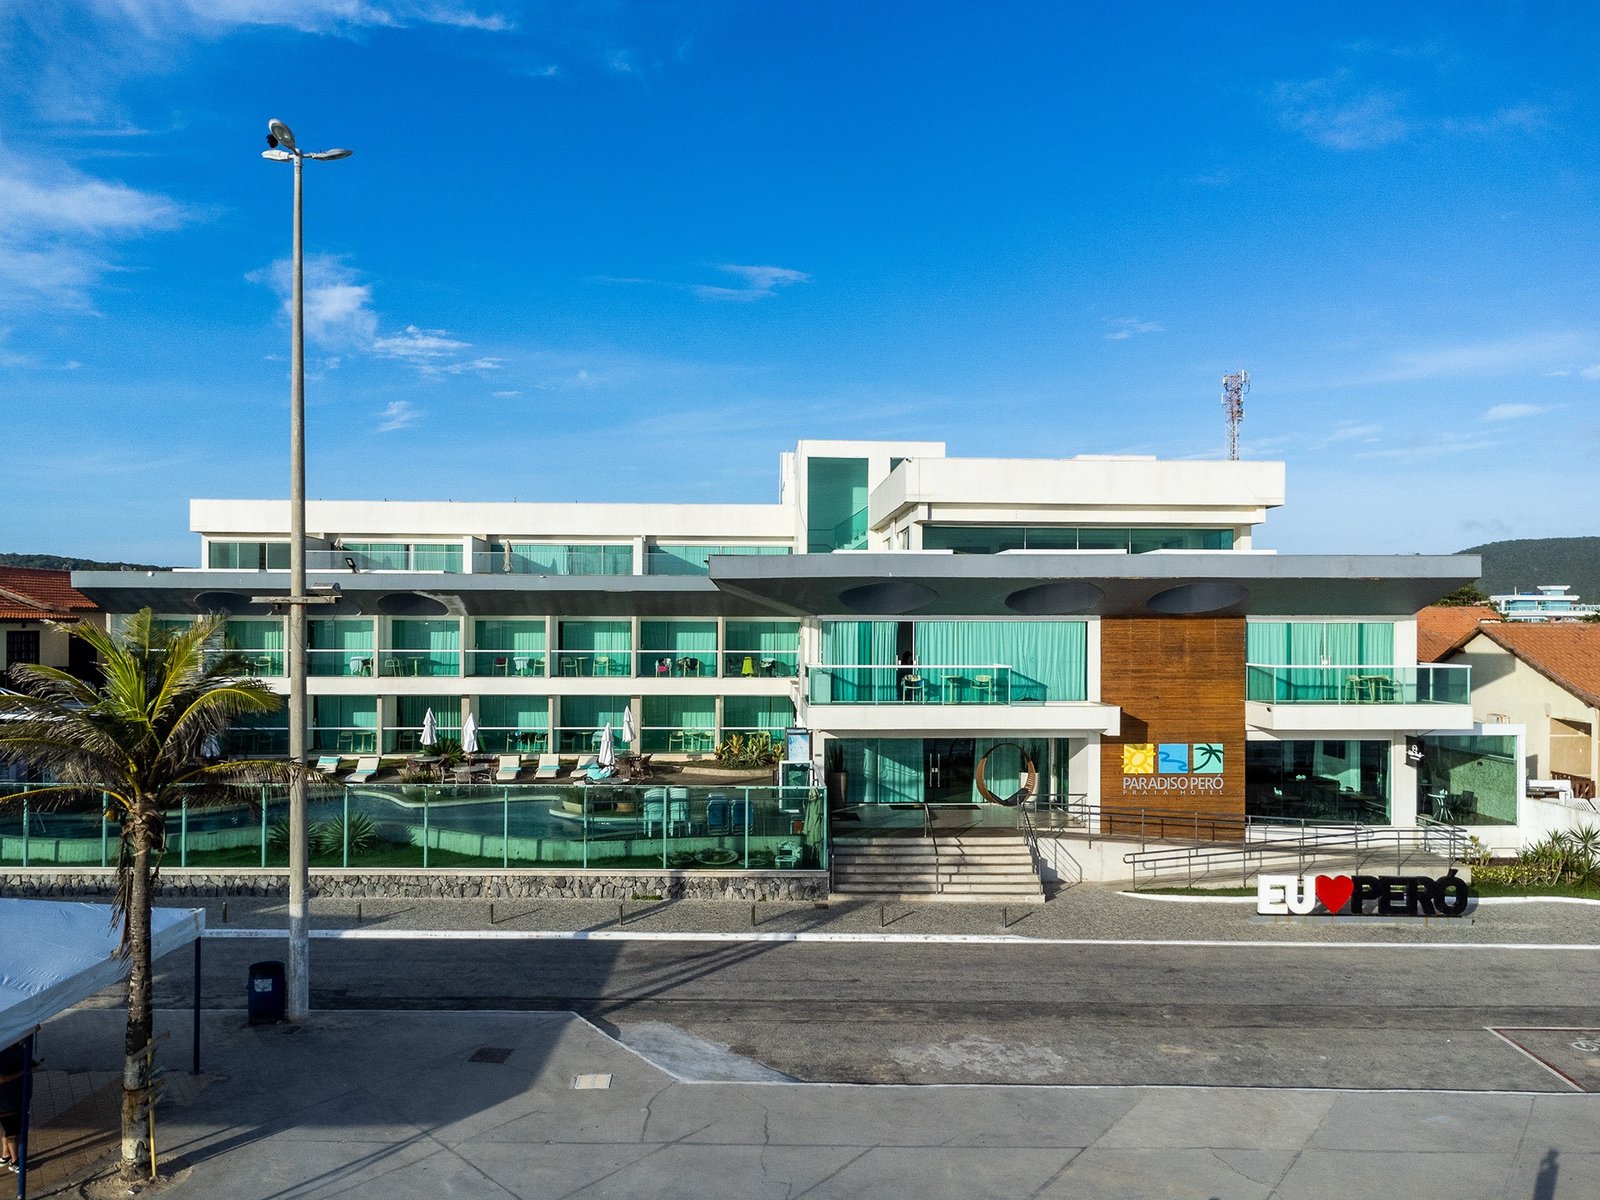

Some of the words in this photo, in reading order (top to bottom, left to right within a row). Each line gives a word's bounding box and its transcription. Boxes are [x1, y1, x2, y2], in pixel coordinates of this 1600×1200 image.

[1123, 777, 1188, 789] PARADISO
[1190, 774, 1223, 789] PERÓ
[1257, 874, 1316, 915] EU
[1351, 868, 1469, 916] PERÓ
